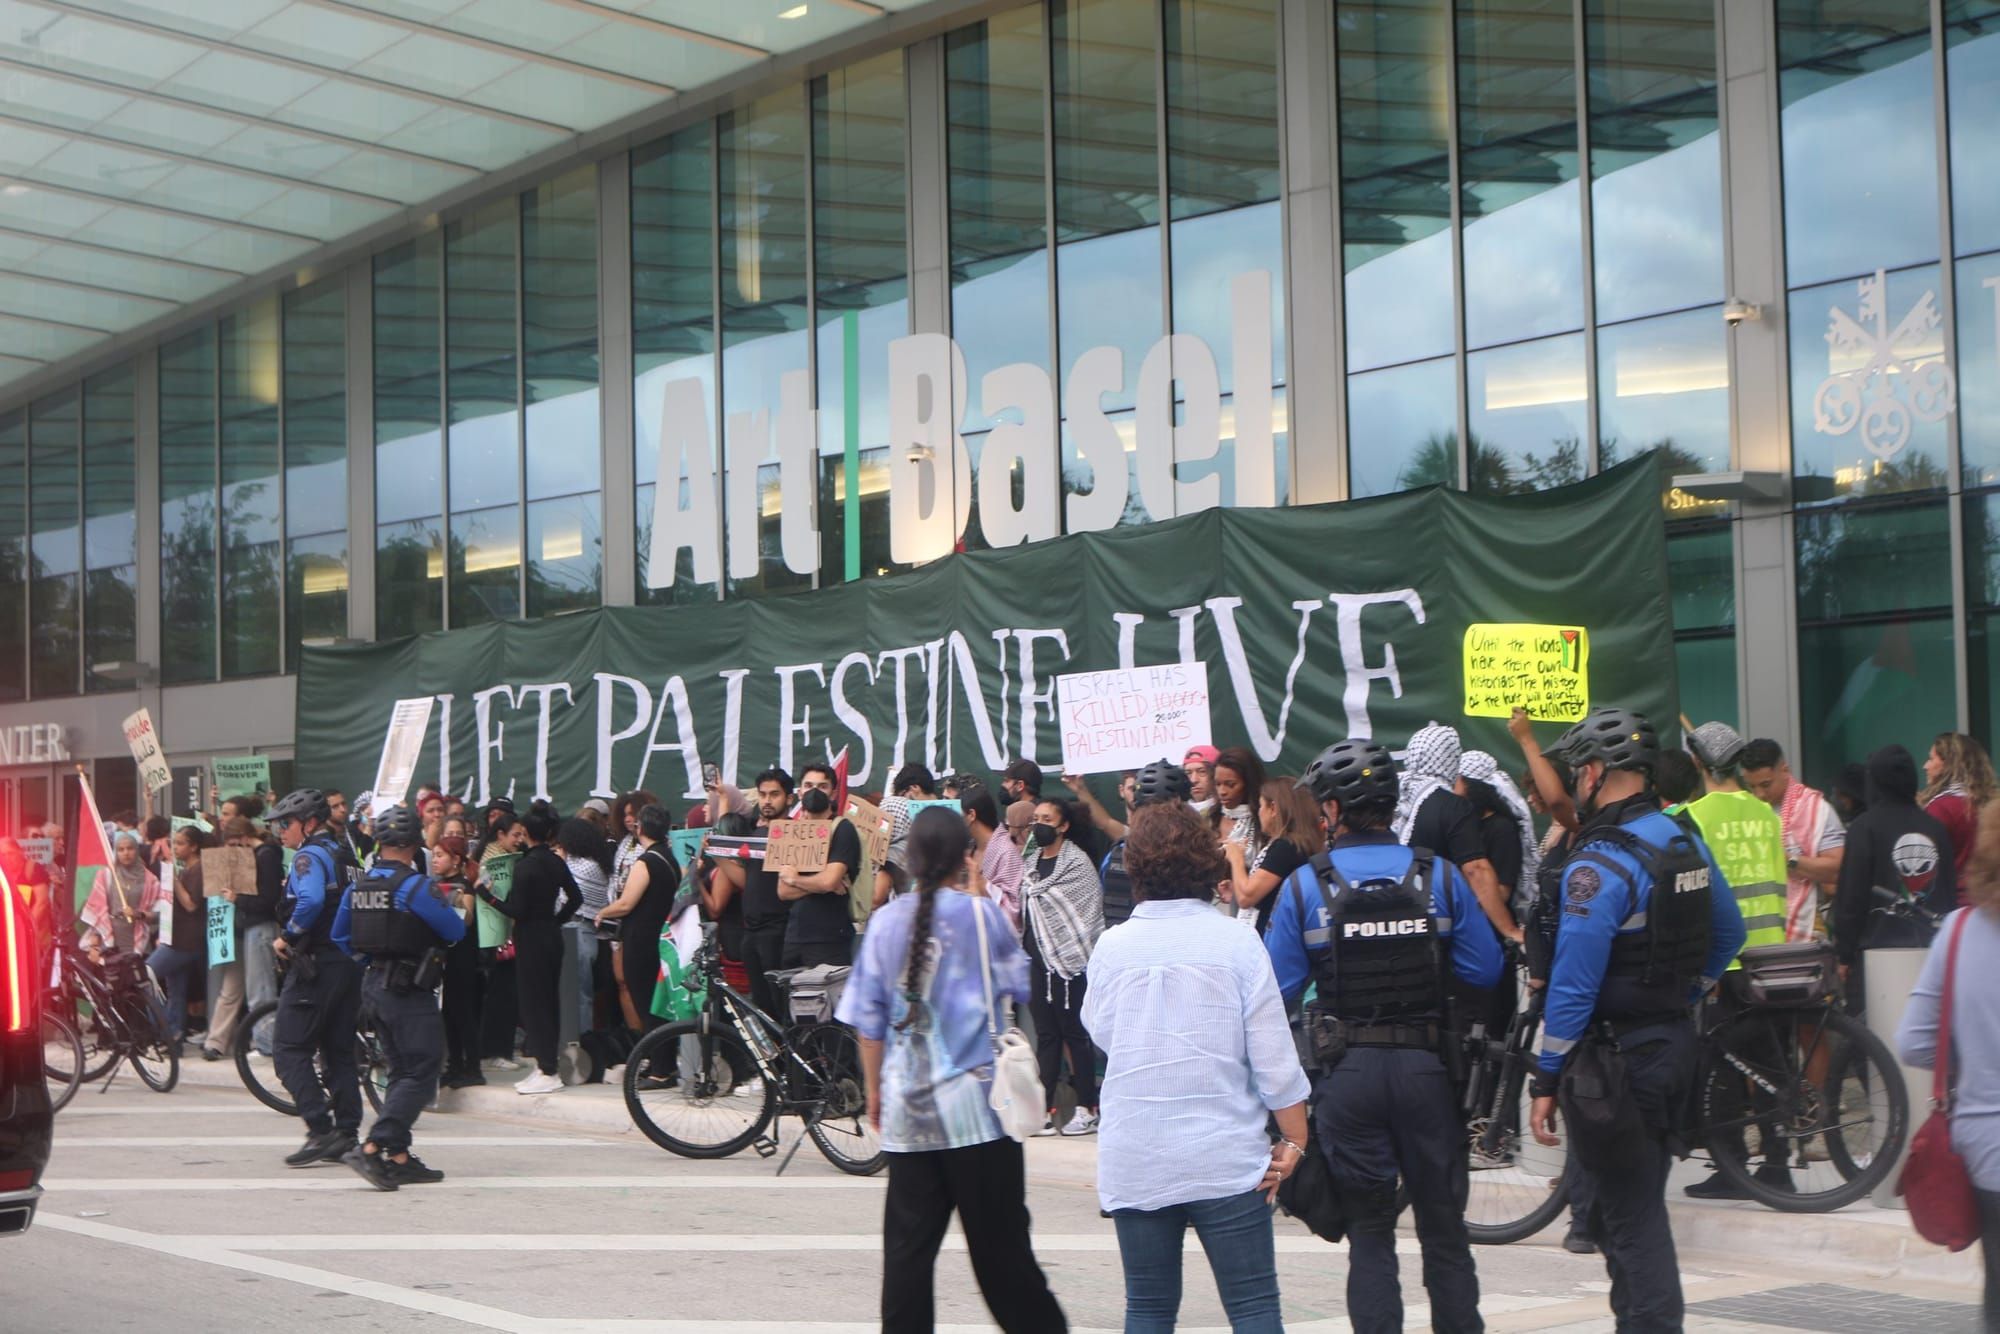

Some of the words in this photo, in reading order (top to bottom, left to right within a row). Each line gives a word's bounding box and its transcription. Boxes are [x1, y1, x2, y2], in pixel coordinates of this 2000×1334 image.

[648, 369, 819, 589] Art
[888, 270, 1275, 564] Basel
[1507, 637, 1525, 653] the
[1534, 636, 1561, 653] lions
[1503, 656, 1531, 672] their
[1060, 671, 1142, 703] ISRAEL
[1151, 665, 1188, 689] HAS
[435, 682, 574, 807] LET
[592, 628, 1071, 799] PALESTINE
[1071, 693, 1149, 729] KILLED
[1066, 720, 1193, 760] PALESTINIANS
[216, 761, 266, 771] CEASEFIRE
[217, 770, 259, 779] FOREVER
[783, 823, 817, 840] FREE
[1715, 820, 1774, 841] JEWS
[767, 841, 828, 867] PALESTINE
[1725, 841, 1770, 861] SAY
[351, 891, 389, 910] POLICE
[1344, 918, 1428, 938] POLICE
[1724, 1052, 1777, 1095] POLICE
